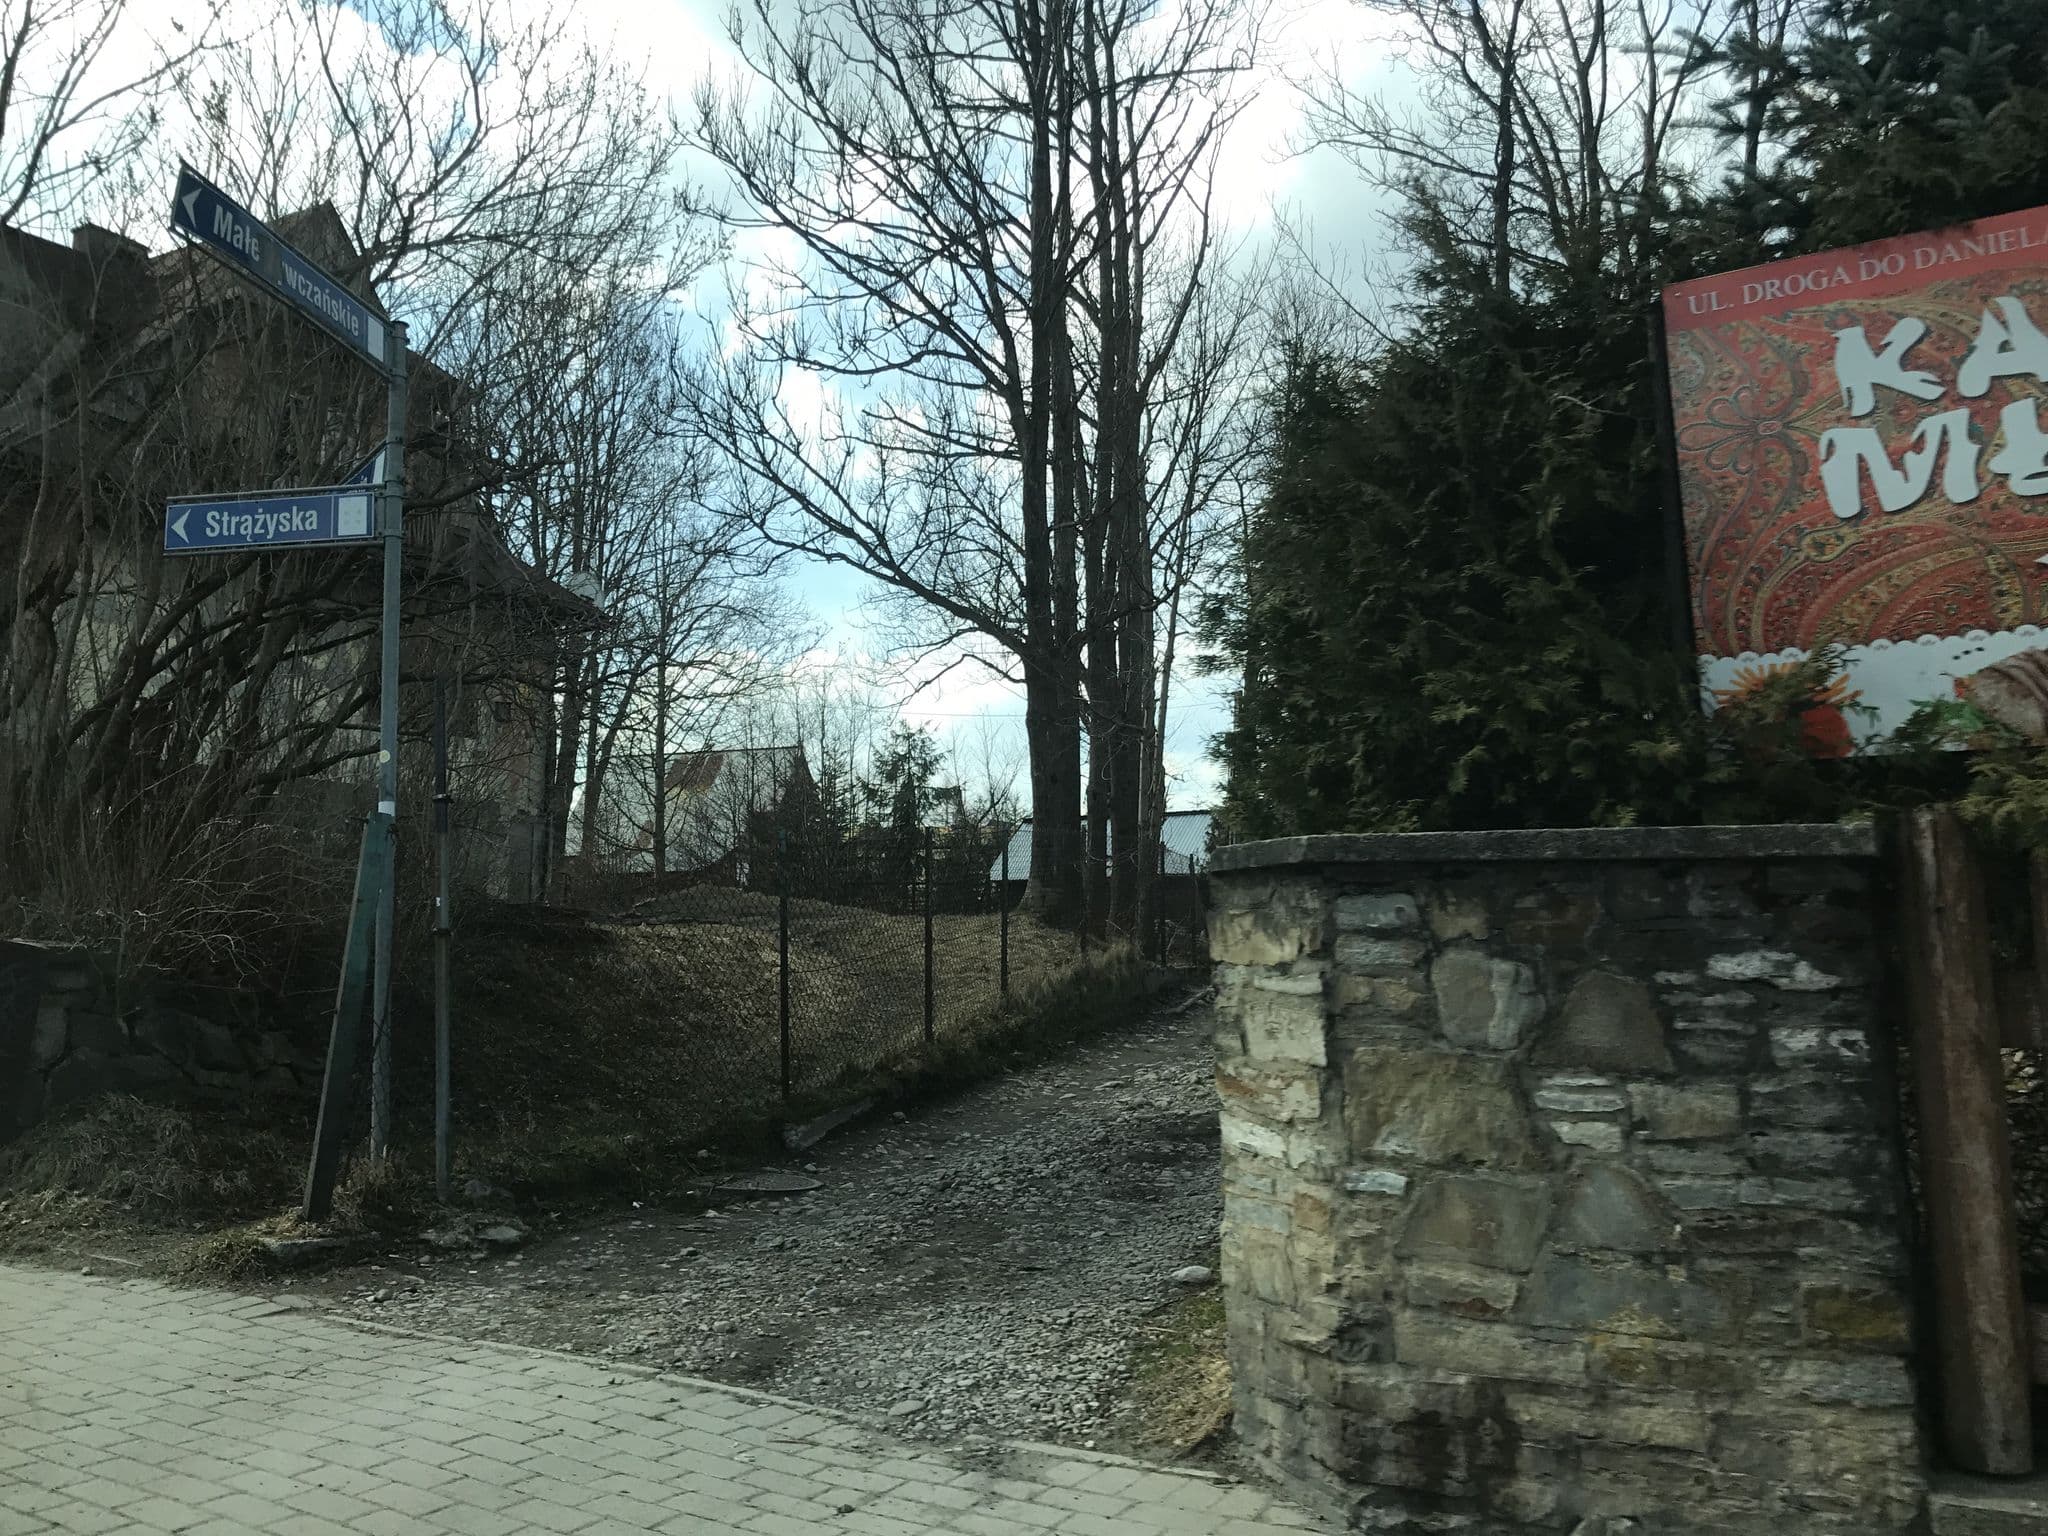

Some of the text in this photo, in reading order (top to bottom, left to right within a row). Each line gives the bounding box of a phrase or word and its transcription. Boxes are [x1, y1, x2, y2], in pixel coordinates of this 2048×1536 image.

[213, 204, 260, 262] Małe
[1688, 225, 2048, 316] UL. DROGA DO DANIEL
[205, 505, 318, 542] Strążyska
